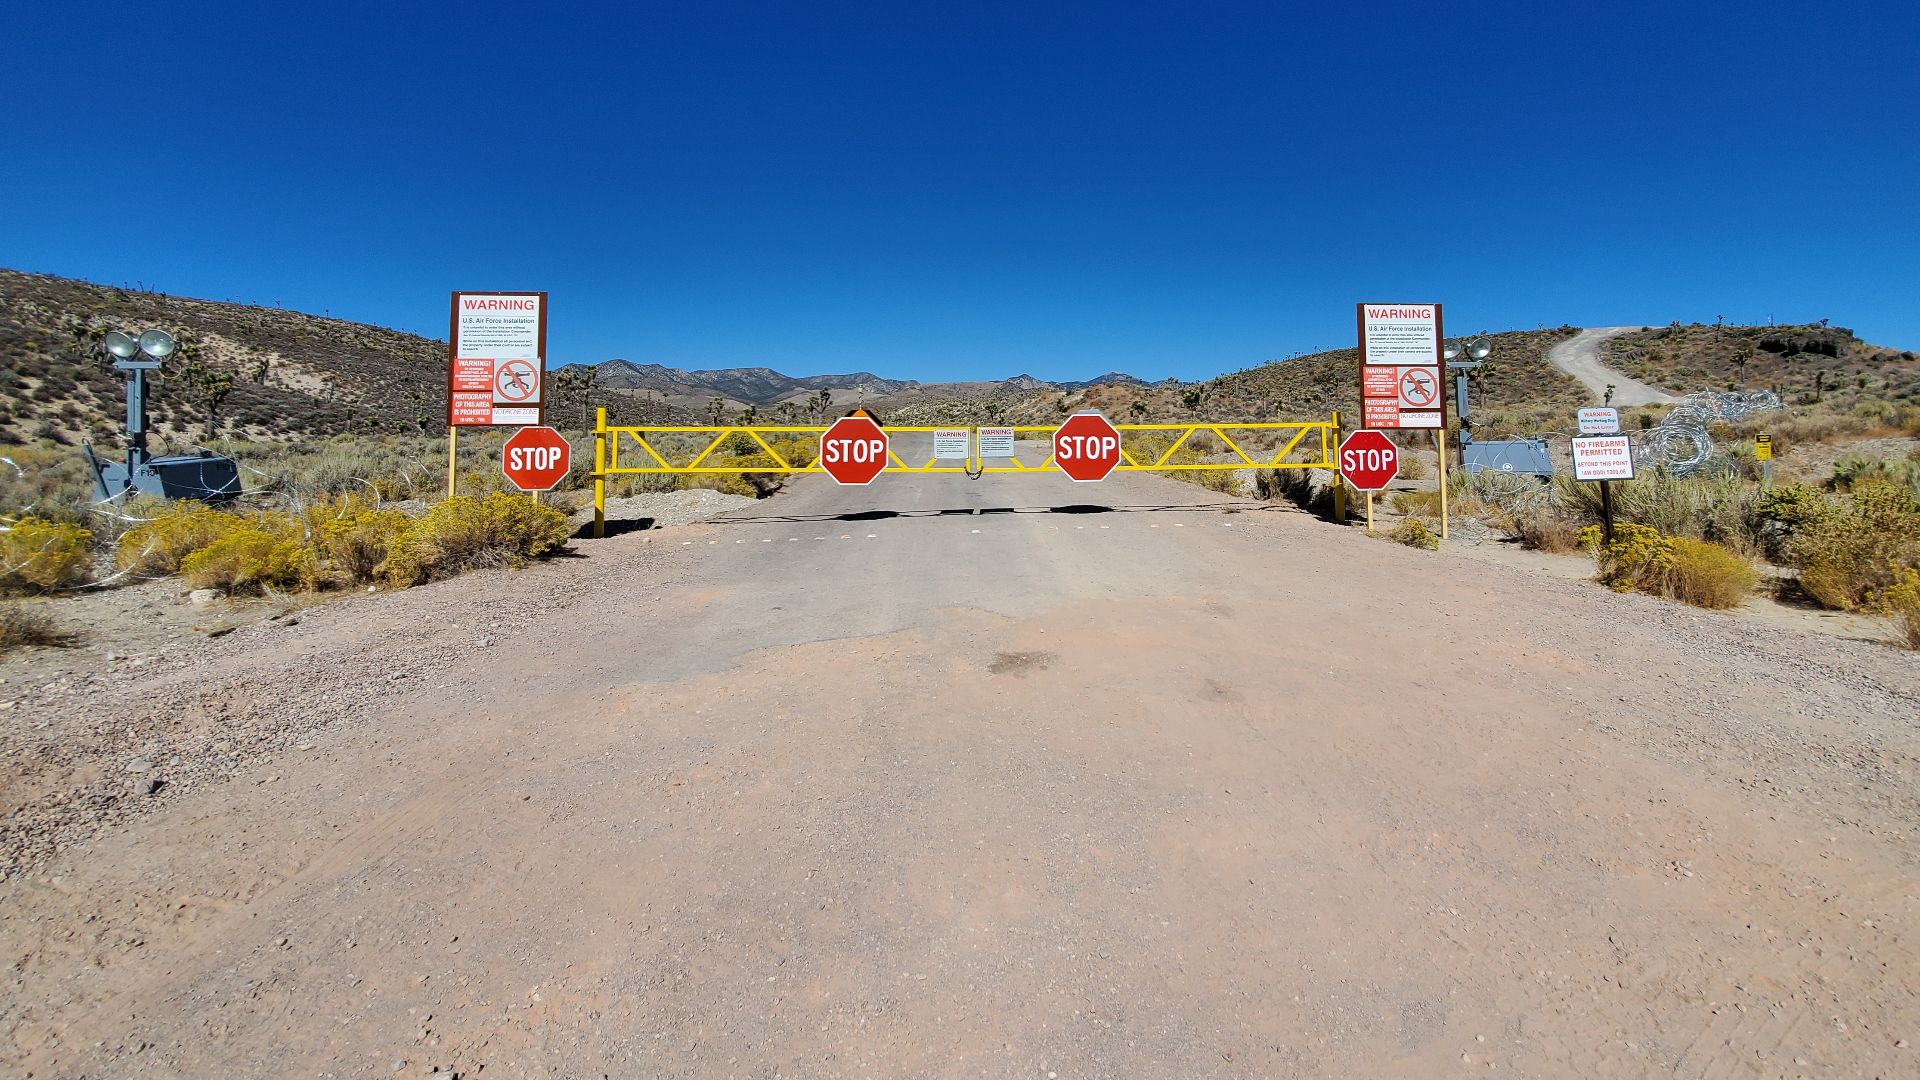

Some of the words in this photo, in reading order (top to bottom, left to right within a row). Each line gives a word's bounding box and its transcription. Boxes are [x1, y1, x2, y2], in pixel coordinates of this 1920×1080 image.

[464, 300, 534, 310] WARNING
[1368, 309, 1431, 318] WARNING
[510, 447, 561, 470] STOP
[826, 439, 884, 463] STOP
[1059, 436, 1116, 459] STOP
[1344, 449, 1393, 471] STOP
